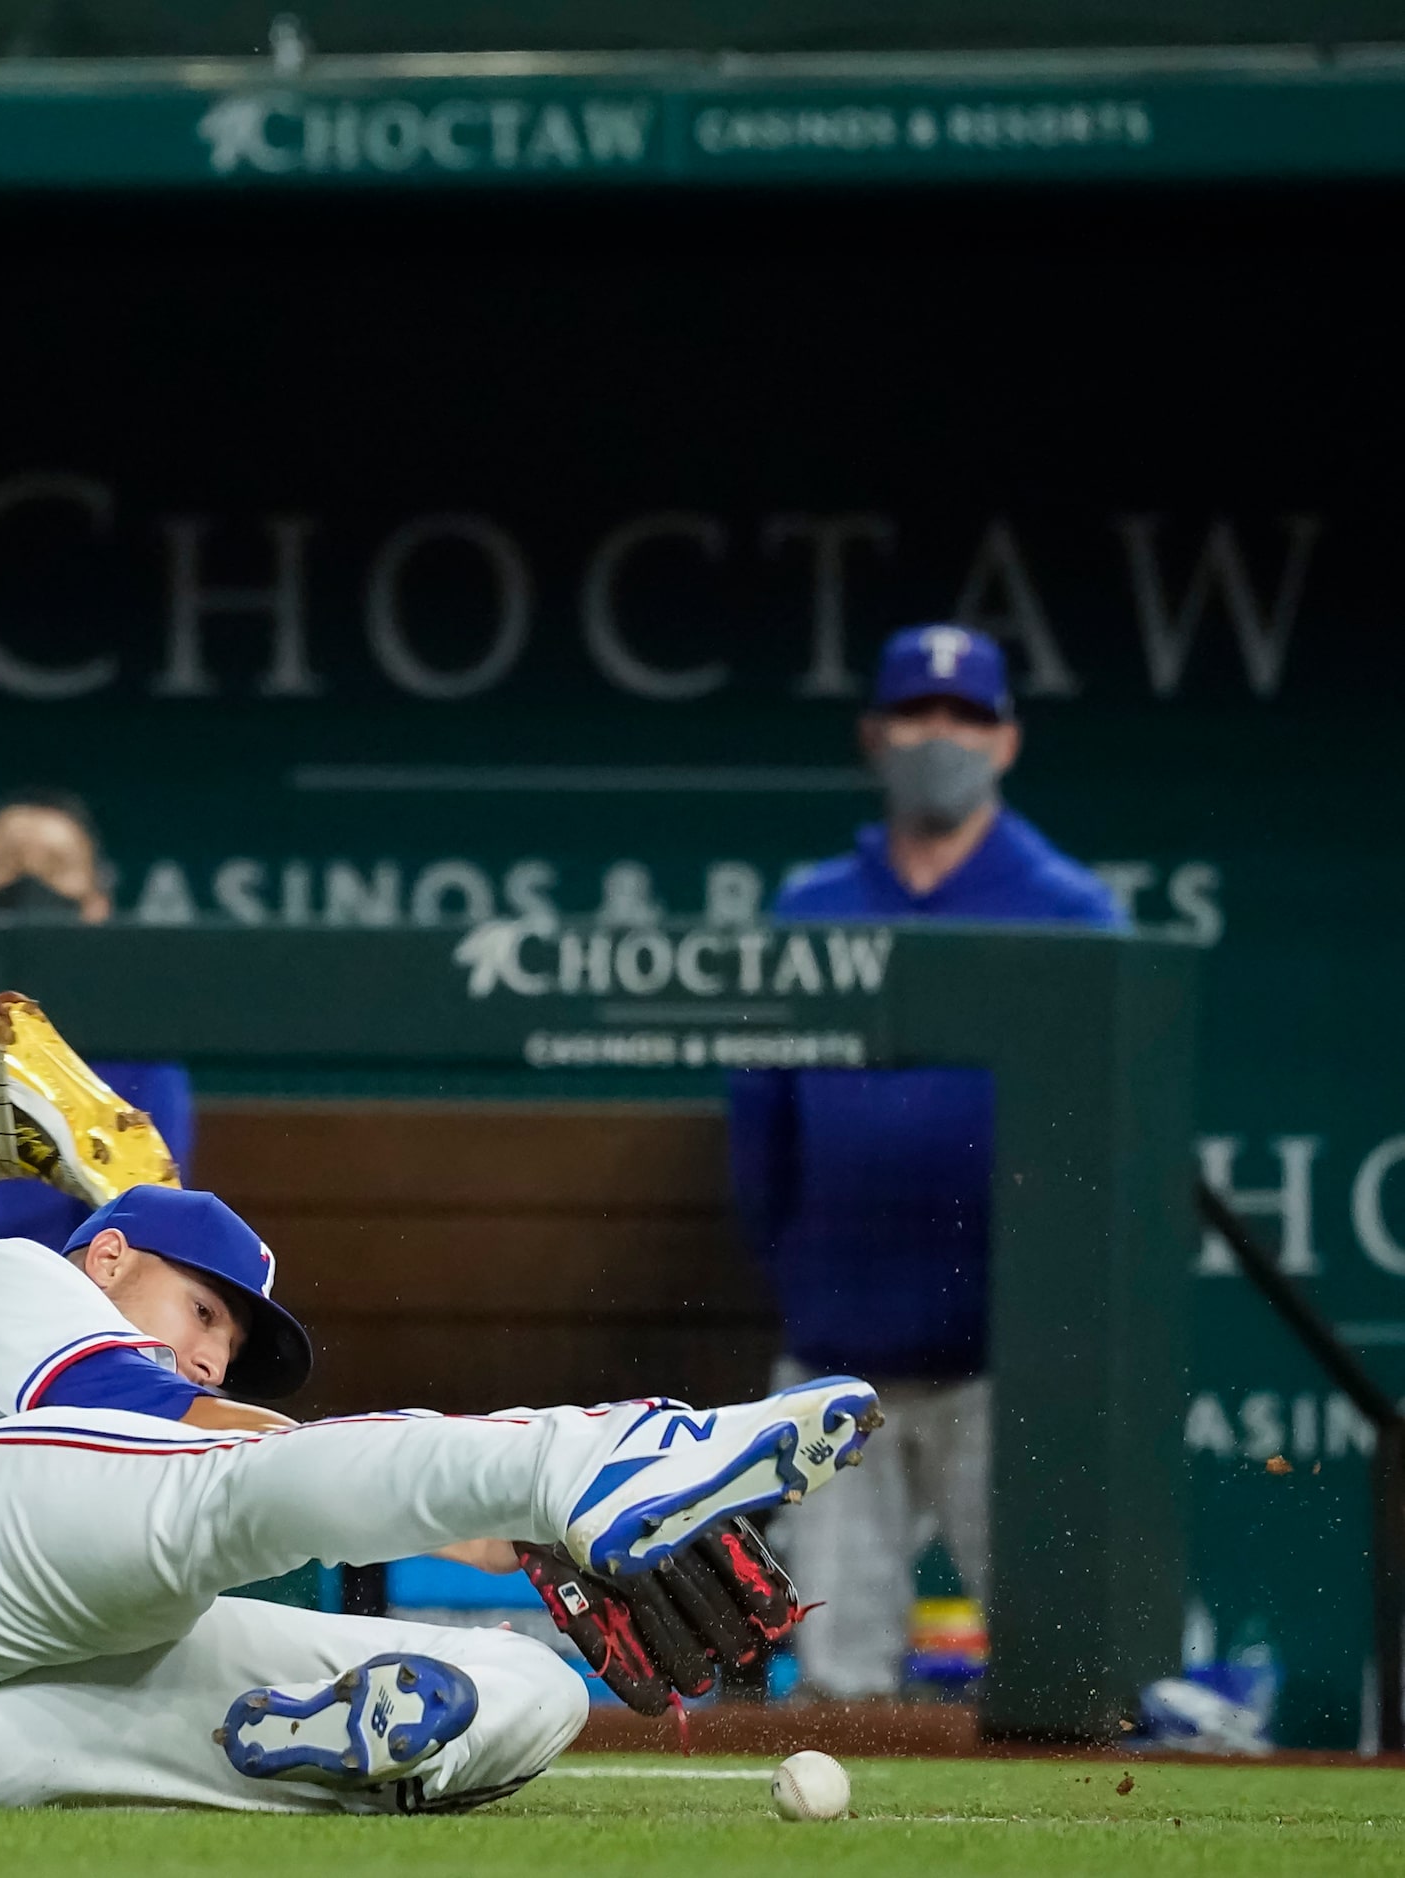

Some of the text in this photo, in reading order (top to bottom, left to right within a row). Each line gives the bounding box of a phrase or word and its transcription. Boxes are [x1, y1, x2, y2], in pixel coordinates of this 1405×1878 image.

[244, 92, 650, 172] CHOCTAW
[134, 856, 560, 932] ASINOS
[508, 922, 894, 997] CHOCTAW
